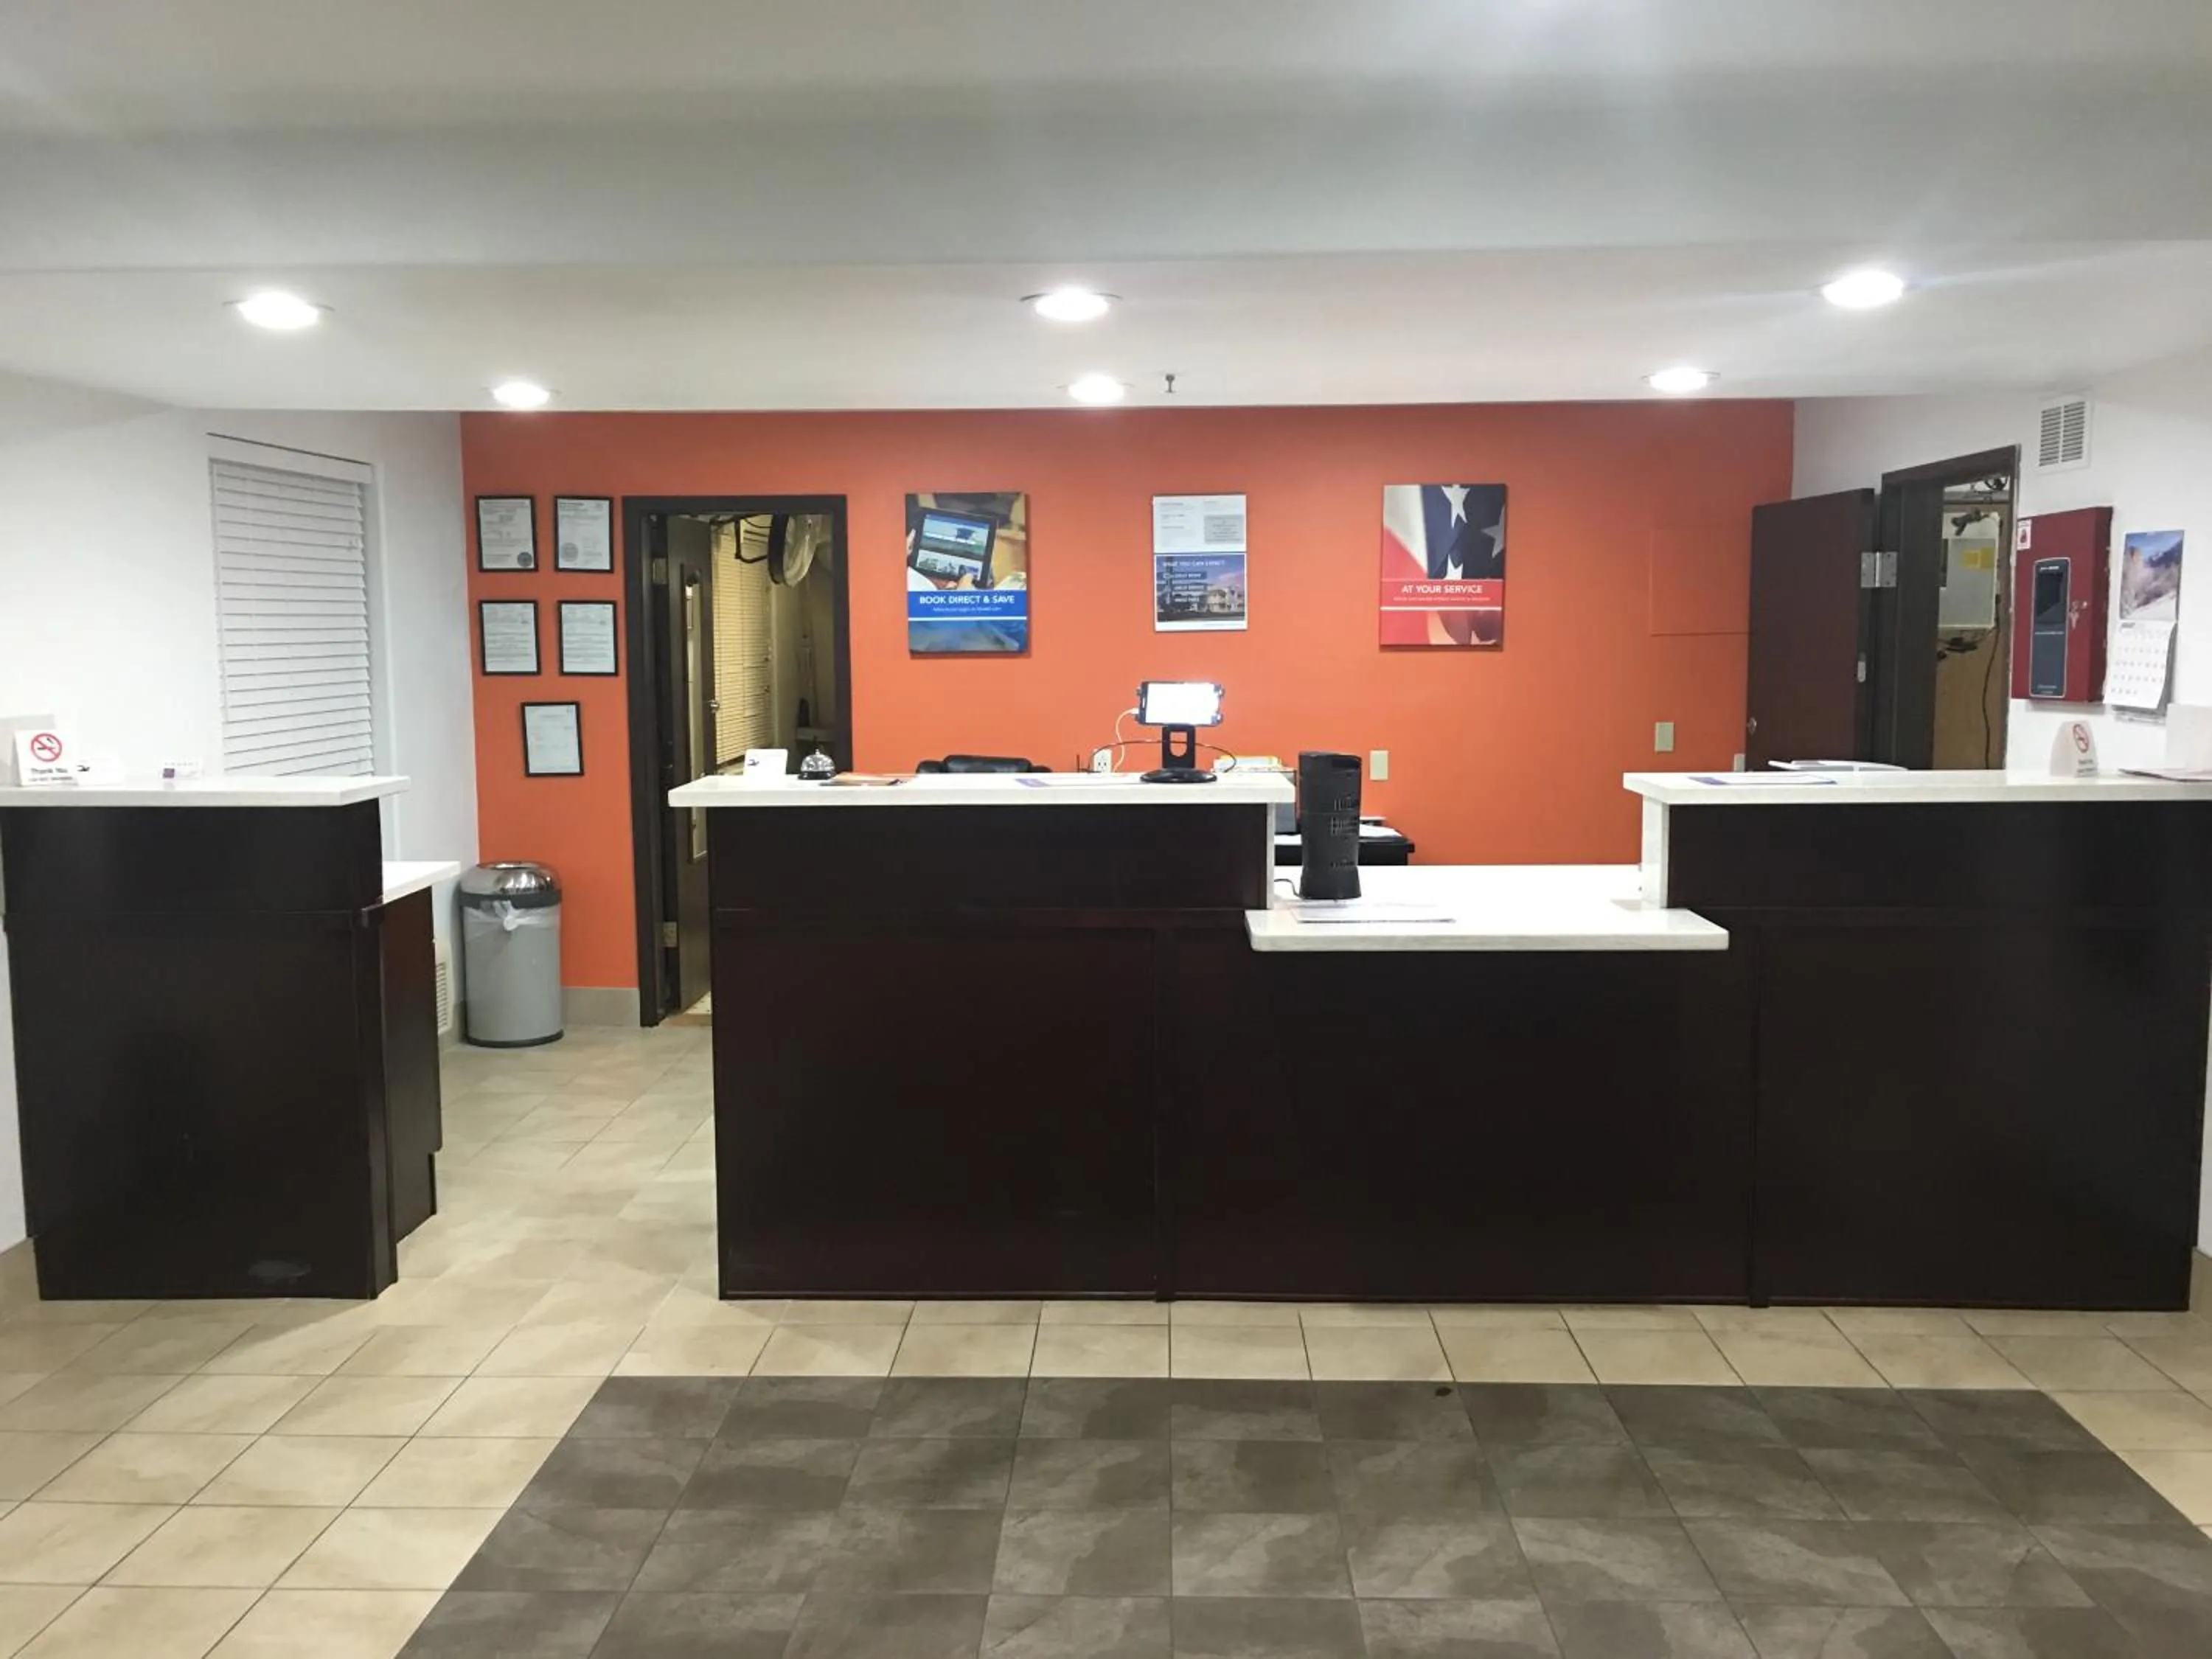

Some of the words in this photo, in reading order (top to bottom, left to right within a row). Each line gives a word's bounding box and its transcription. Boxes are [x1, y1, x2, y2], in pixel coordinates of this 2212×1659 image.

[1402, 585, 1413, 594] AT
[1415, 585, 1441, 594] YOUR
[1444, 585, 1483, 594] SERVICE
[919, 595, 946, 604] BOOK
[948, 595, 981, 604] DIRECT
[983, 595, 990, 604] &
[992, 595, 1015, 604] SAVE
